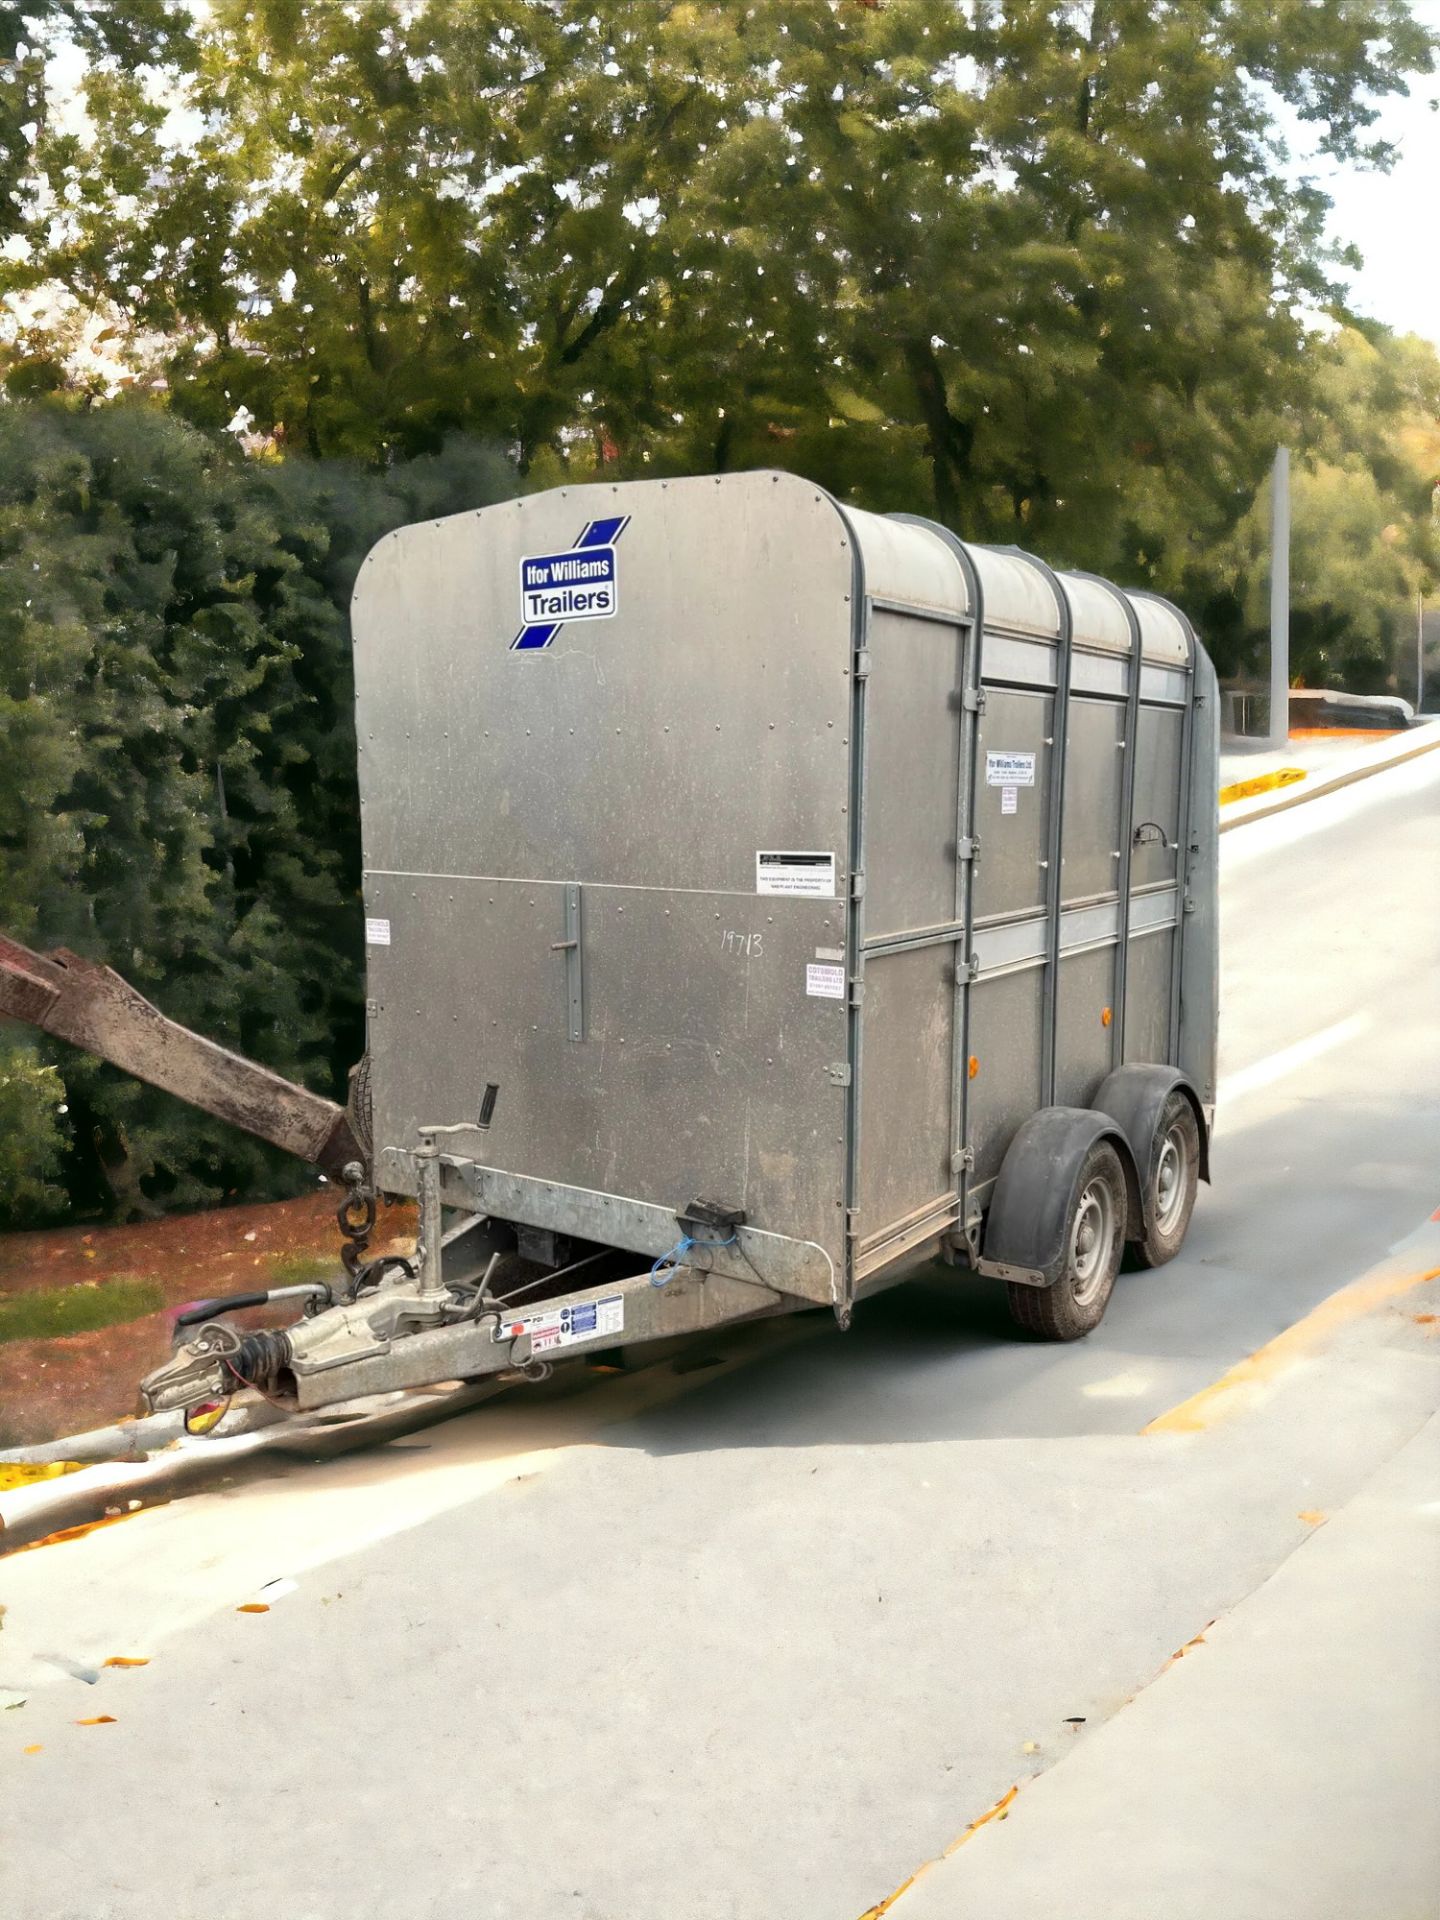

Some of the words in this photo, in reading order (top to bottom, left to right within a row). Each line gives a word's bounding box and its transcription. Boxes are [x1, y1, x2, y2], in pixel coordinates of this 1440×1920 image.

[527, 565, 549, 585] Ifor
[550, 559, 610, 582] Williams
[528, 590, 610, 615] Trailers
[721, 929, 763, 958] 19713
